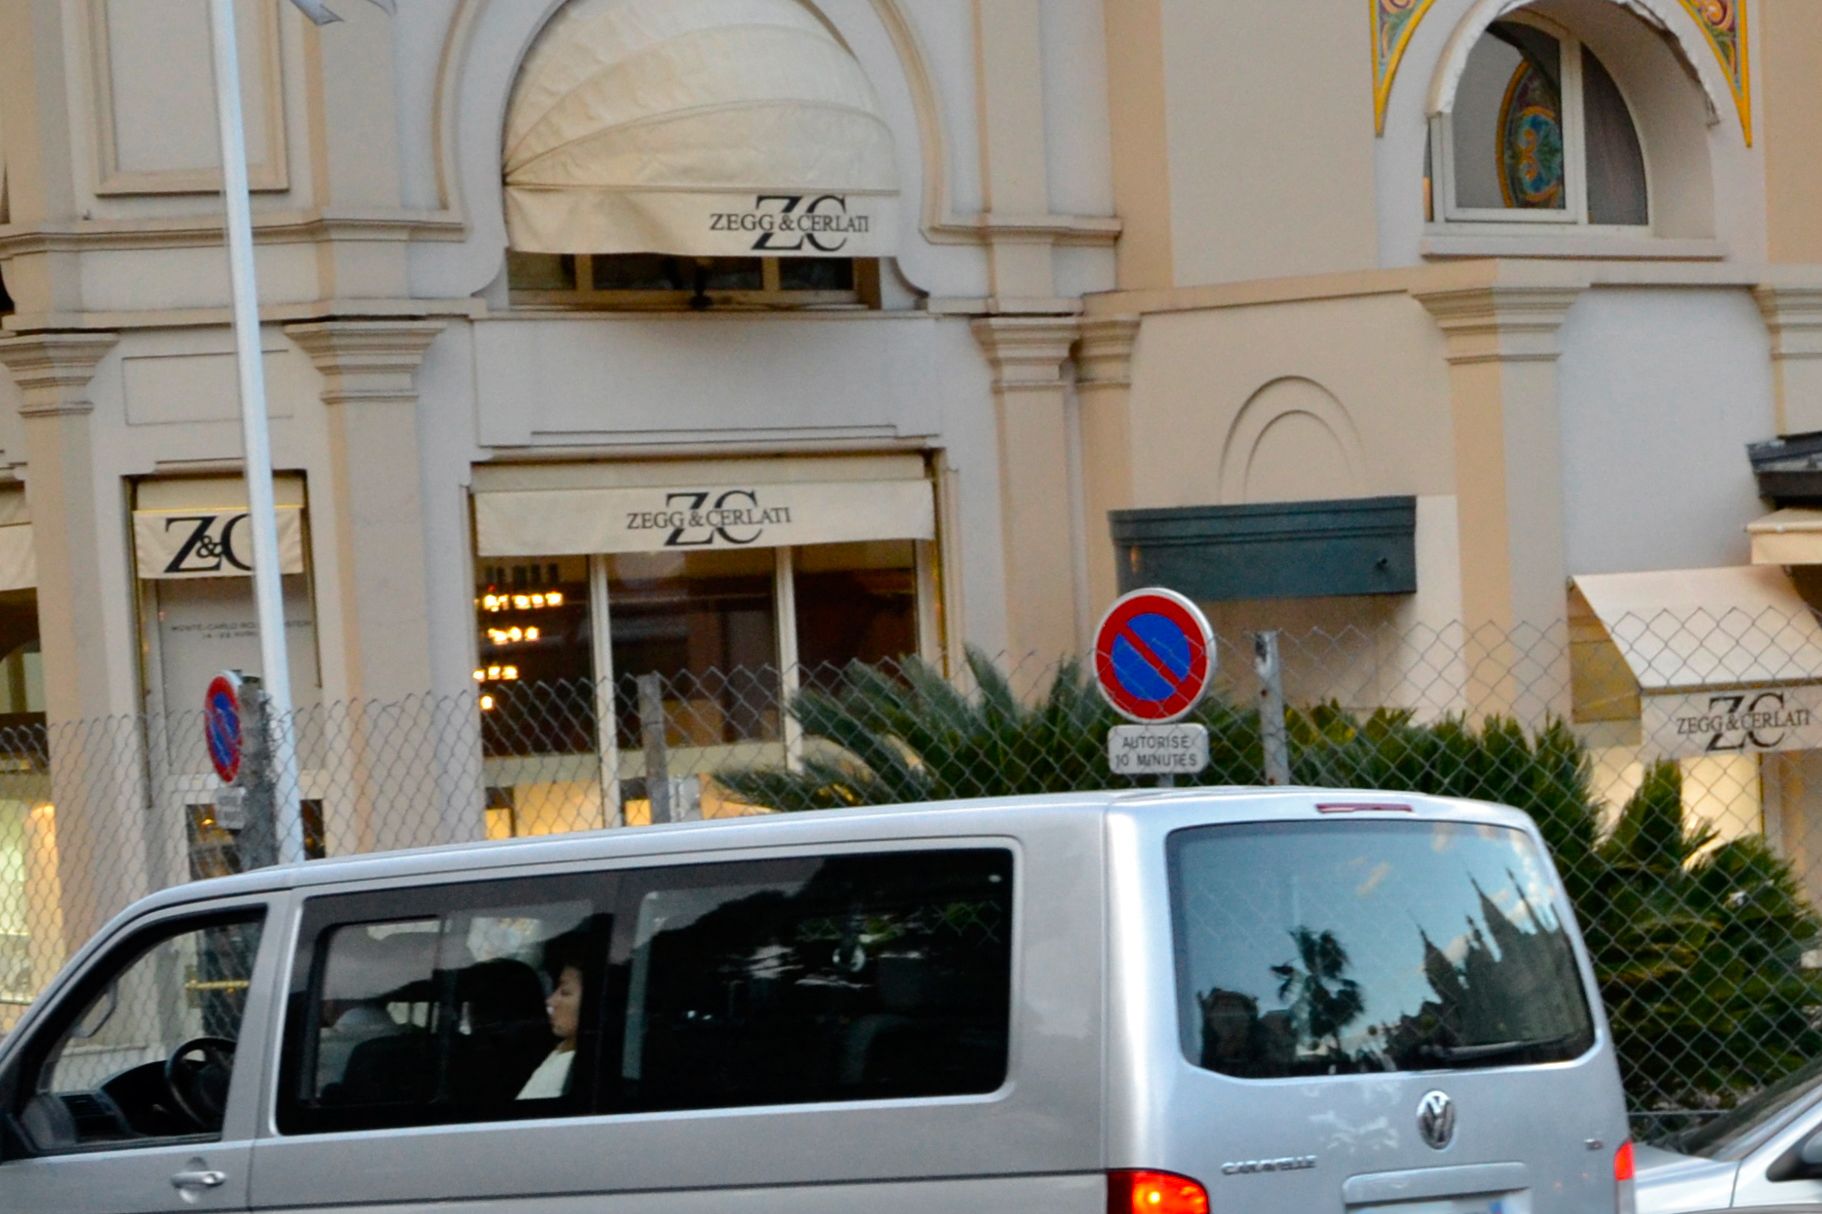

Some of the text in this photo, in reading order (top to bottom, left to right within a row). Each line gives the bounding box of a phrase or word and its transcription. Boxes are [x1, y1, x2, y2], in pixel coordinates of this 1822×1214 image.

[709, 213, 775, 231] ZEGG
[778, 214, 795, 232] &
[626, 506, 791, 530] ZEGG & CERLATI
[1677, 717, 1723, 735] ZEGG
[1741, 709, 1811, 730] CERLATI
[1123, 735, 1190, 749] AUTORISE
[1116, 753, 1197, 767] 10 MINUTES
